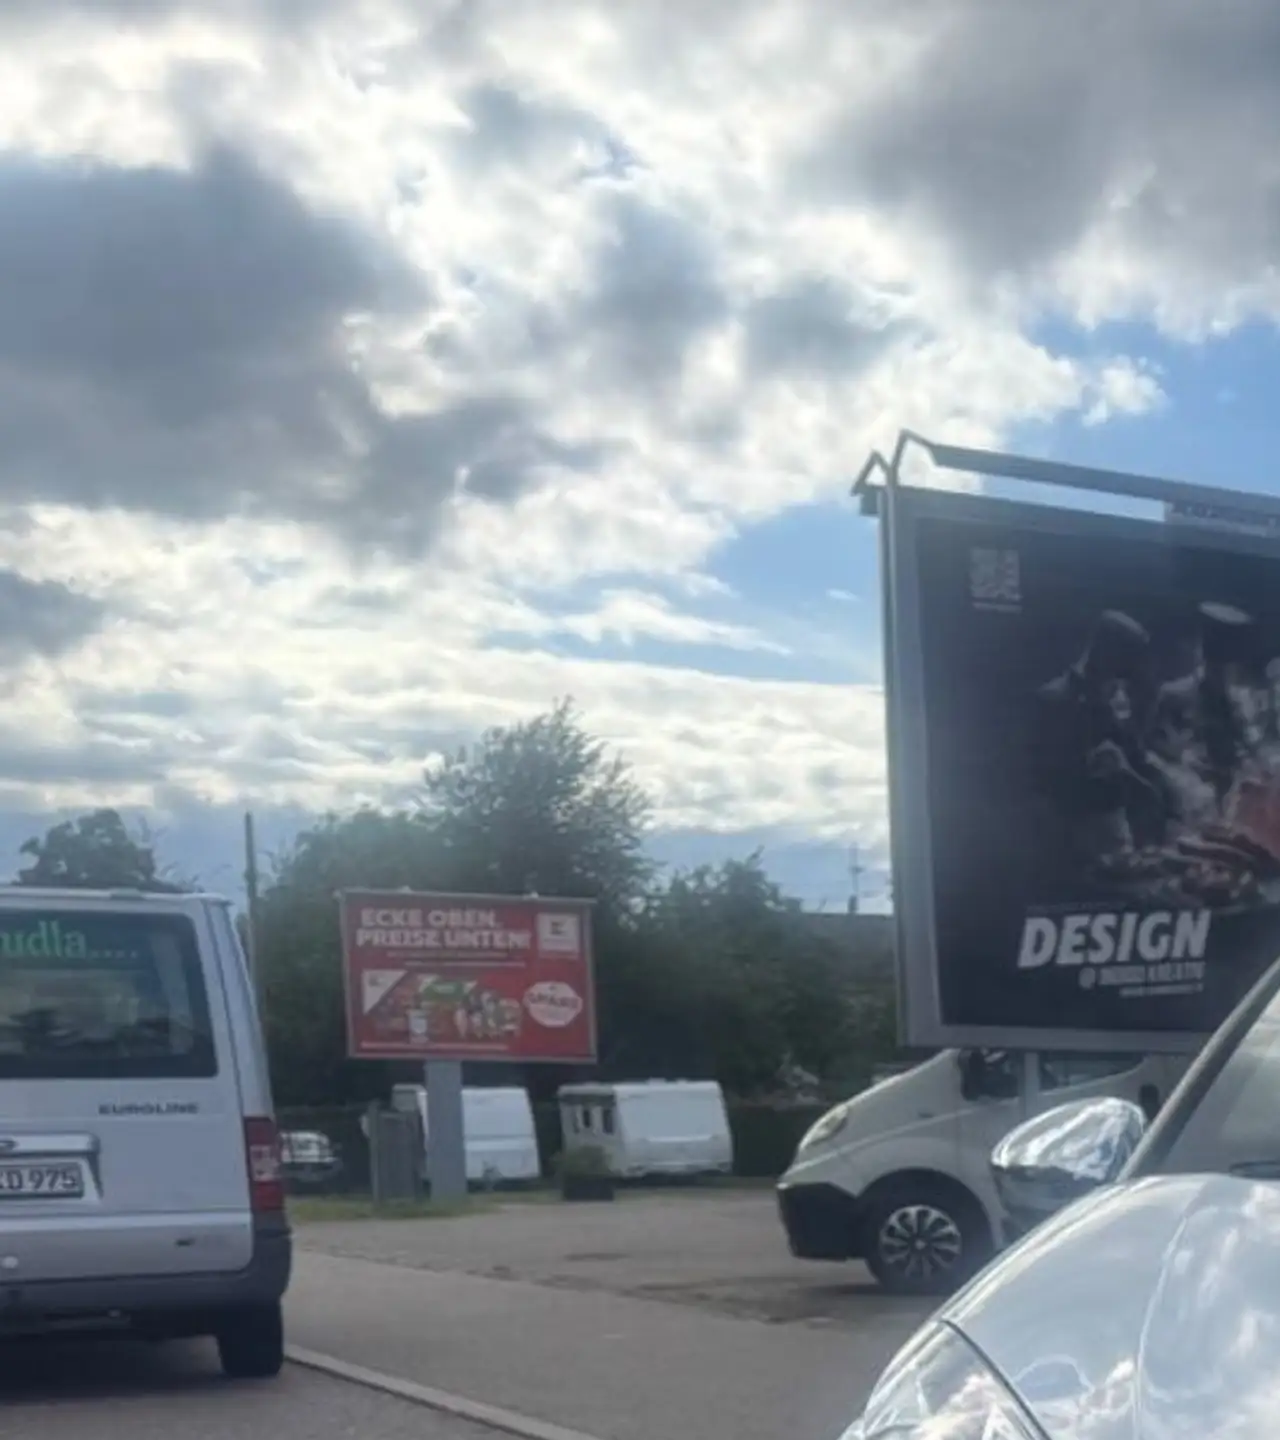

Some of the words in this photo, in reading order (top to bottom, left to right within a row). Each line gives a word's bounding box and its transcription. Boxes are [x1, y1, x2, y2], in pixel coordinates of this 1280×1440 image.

[361, 908, 423, 926] ECKE
[356, 928, 439, 947] PREISE
[1017, 909, 1212, 968] DESIGN
[98, 1102, 199, 1115] EUROLINE
[29, 1168, 76, 1189] 975
